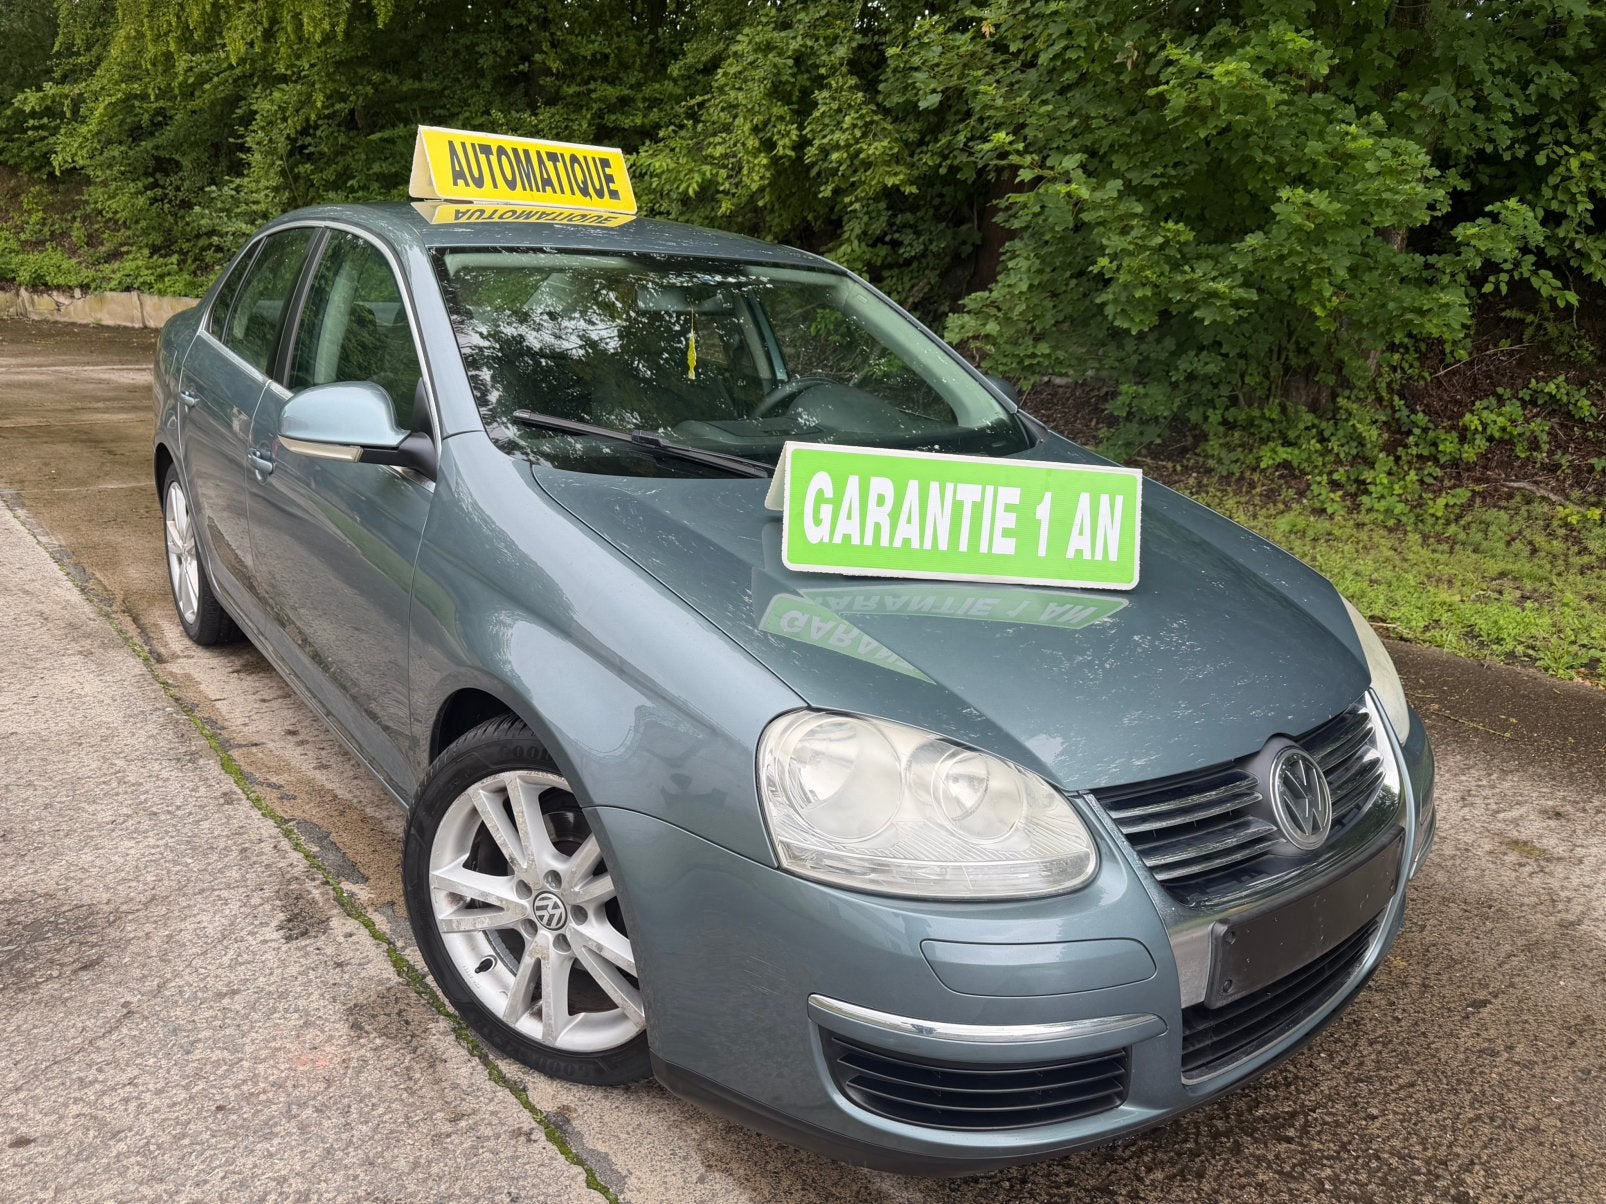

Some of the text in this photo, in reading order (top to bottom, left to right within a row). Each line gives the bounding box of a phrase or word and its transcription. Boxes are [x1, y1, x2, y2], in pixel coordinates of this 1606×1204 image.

[447, 139, 621, 201] AUTOMATIQUE
[803, 471, 1124, 562] GARANTIE 1 AN
[1272, 749, 1331, 848] VW
[533, 891, 567, 931] VW
